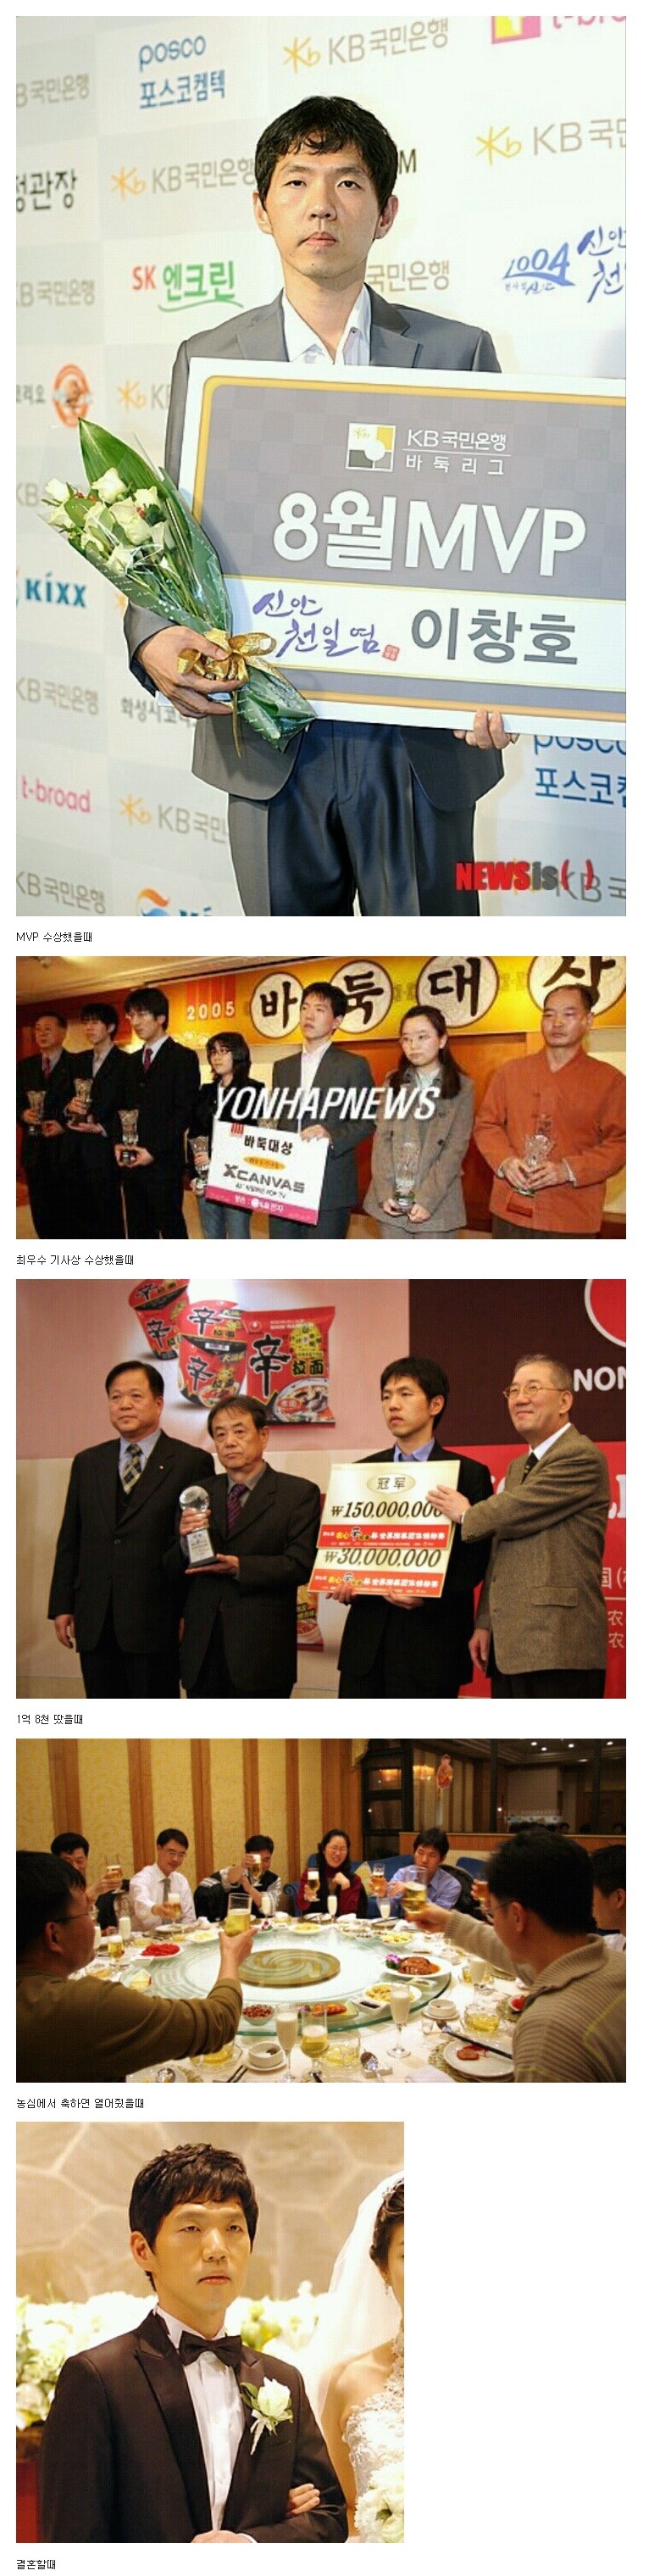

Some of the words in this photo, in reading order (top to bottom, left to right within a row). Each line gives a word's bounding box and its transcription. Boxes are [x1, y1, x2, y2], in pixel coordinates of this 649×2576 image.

[139, 36, 206, 71] posco
[328, 17, 448, 64] KB국민은행
[140, 70, 225, 109] 포스코켐텍
[132, 265, 156, 291] SK
[163, 260, 236, 302] 엔크린
[366, 259, 450, 292] 국민은행
[407, 429, 506, 451] KB국민은행
[411, 607, 578, 665] 이창호
[21, 776, 91, 813] t-broad
[186, 1001, 236, 1021] 2005
[244, 1134, 293, 1155] 바둑대상
[146, 1319, 171, 1349] 辛
[189, 1308, 223, 1334] 辛
[186, 1356, 214, 1391] 辛
[249, 1333, 292, 1398] 辛
